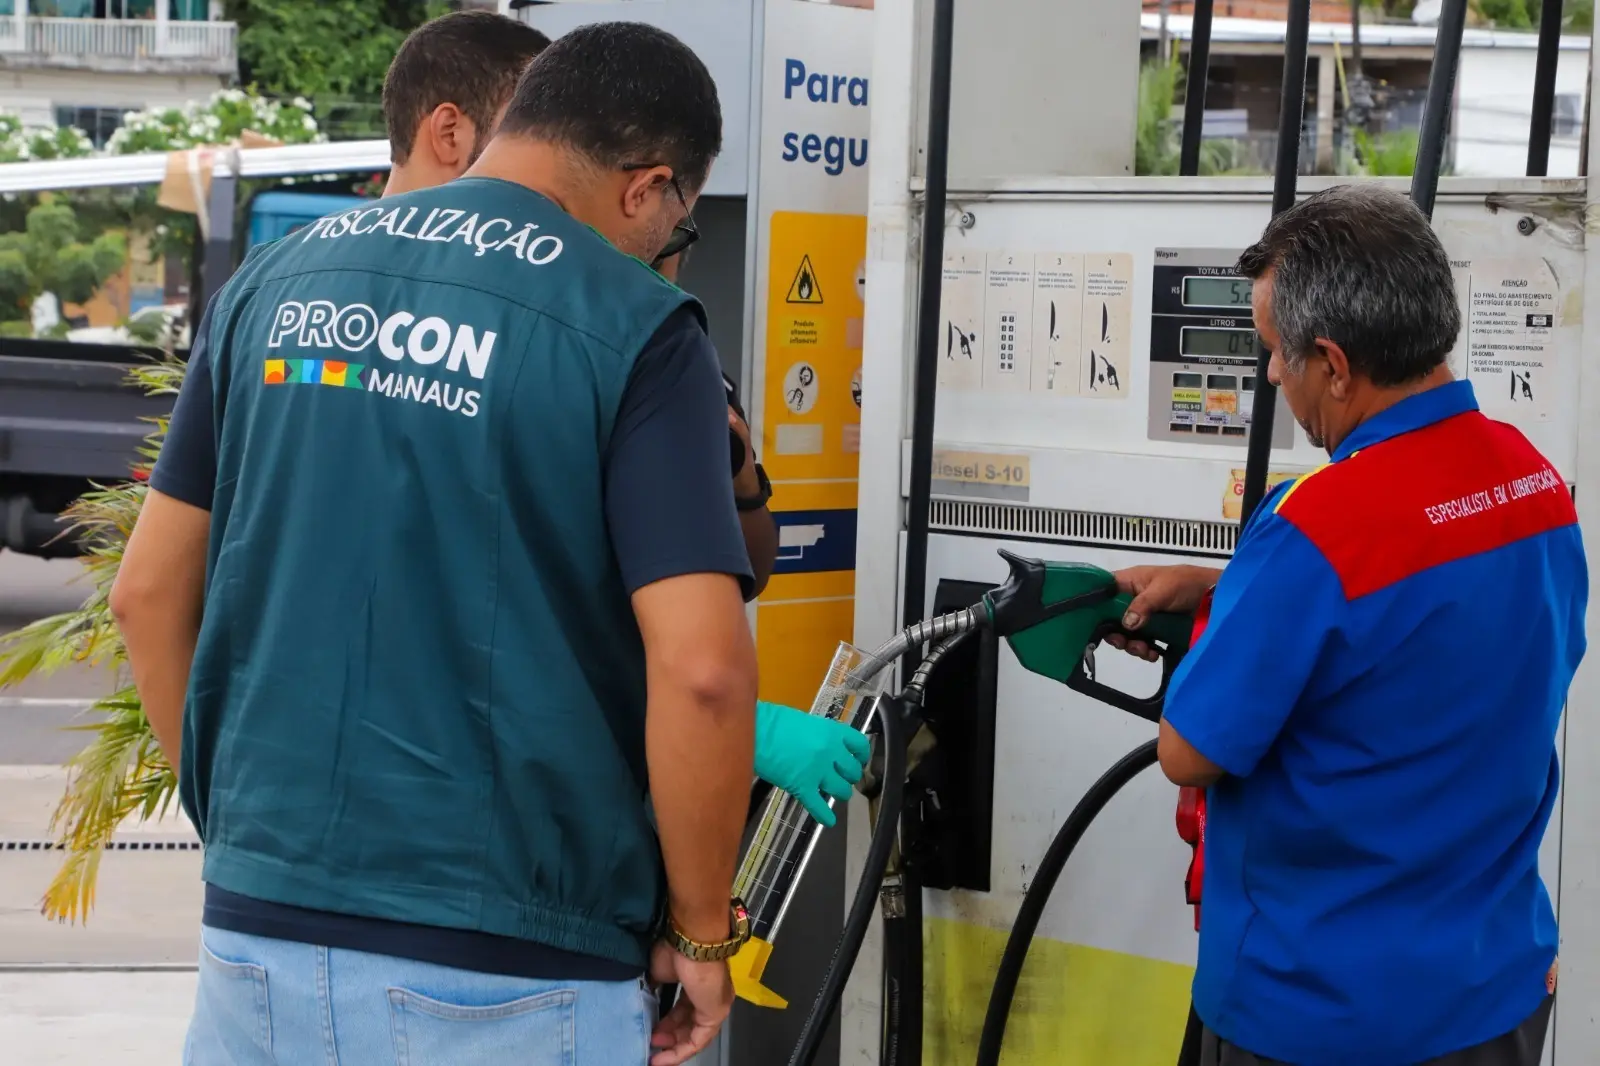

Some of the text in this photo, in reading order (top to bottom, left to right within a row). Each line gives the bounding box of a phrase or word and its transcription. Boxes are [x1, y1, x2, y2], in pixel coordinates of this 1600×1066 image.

[785, 58, 869, 106] Para
[782, 132, 868, 176] segu
[302, 206, 563, 265] FISCALIZAÇÃO
[1008, 256, 1013, 264] 2
[1156, 250, 1178, 258] Wayne
[1057, 257, 1062, 265] 3
[1198, 267, 1220, 275] TOTAL
[1501, 279, 1528, 287] ATENÇÃO
[1171, 286, 1180, 295] R$
[1210, 319, 1235, 327] LITROS
[268, 300, 497, 379] PROCON
[368, 368, 481, 417] MANAUS
[985, 464, 1023, 482] S-10
[1424, 463, 1560, 524] ESPECIALISTA EM LUBRIFICAÇÃ
